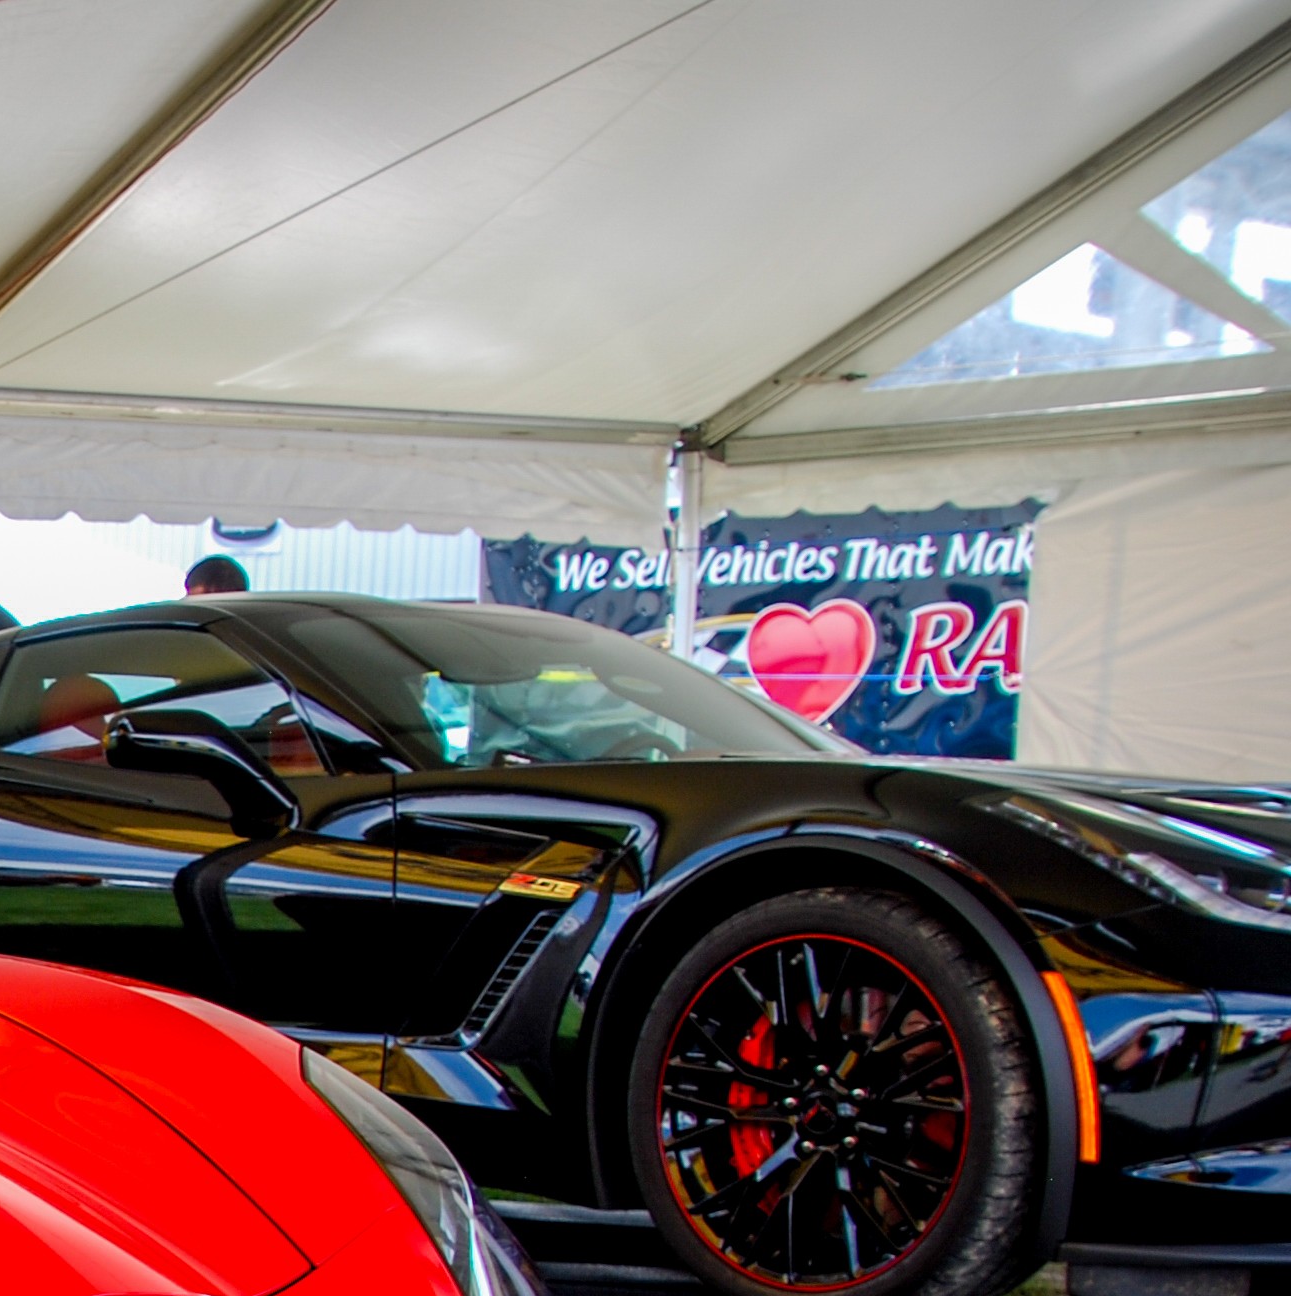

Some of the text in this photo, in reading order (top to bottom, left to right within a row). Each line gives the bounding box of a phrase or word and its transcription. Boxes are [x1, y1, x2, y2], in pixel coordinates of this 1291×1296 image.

[555, 550, 610, 592] We
[696, 539, 839, 587] Vehicles
[844, 533, 938, 582] That
